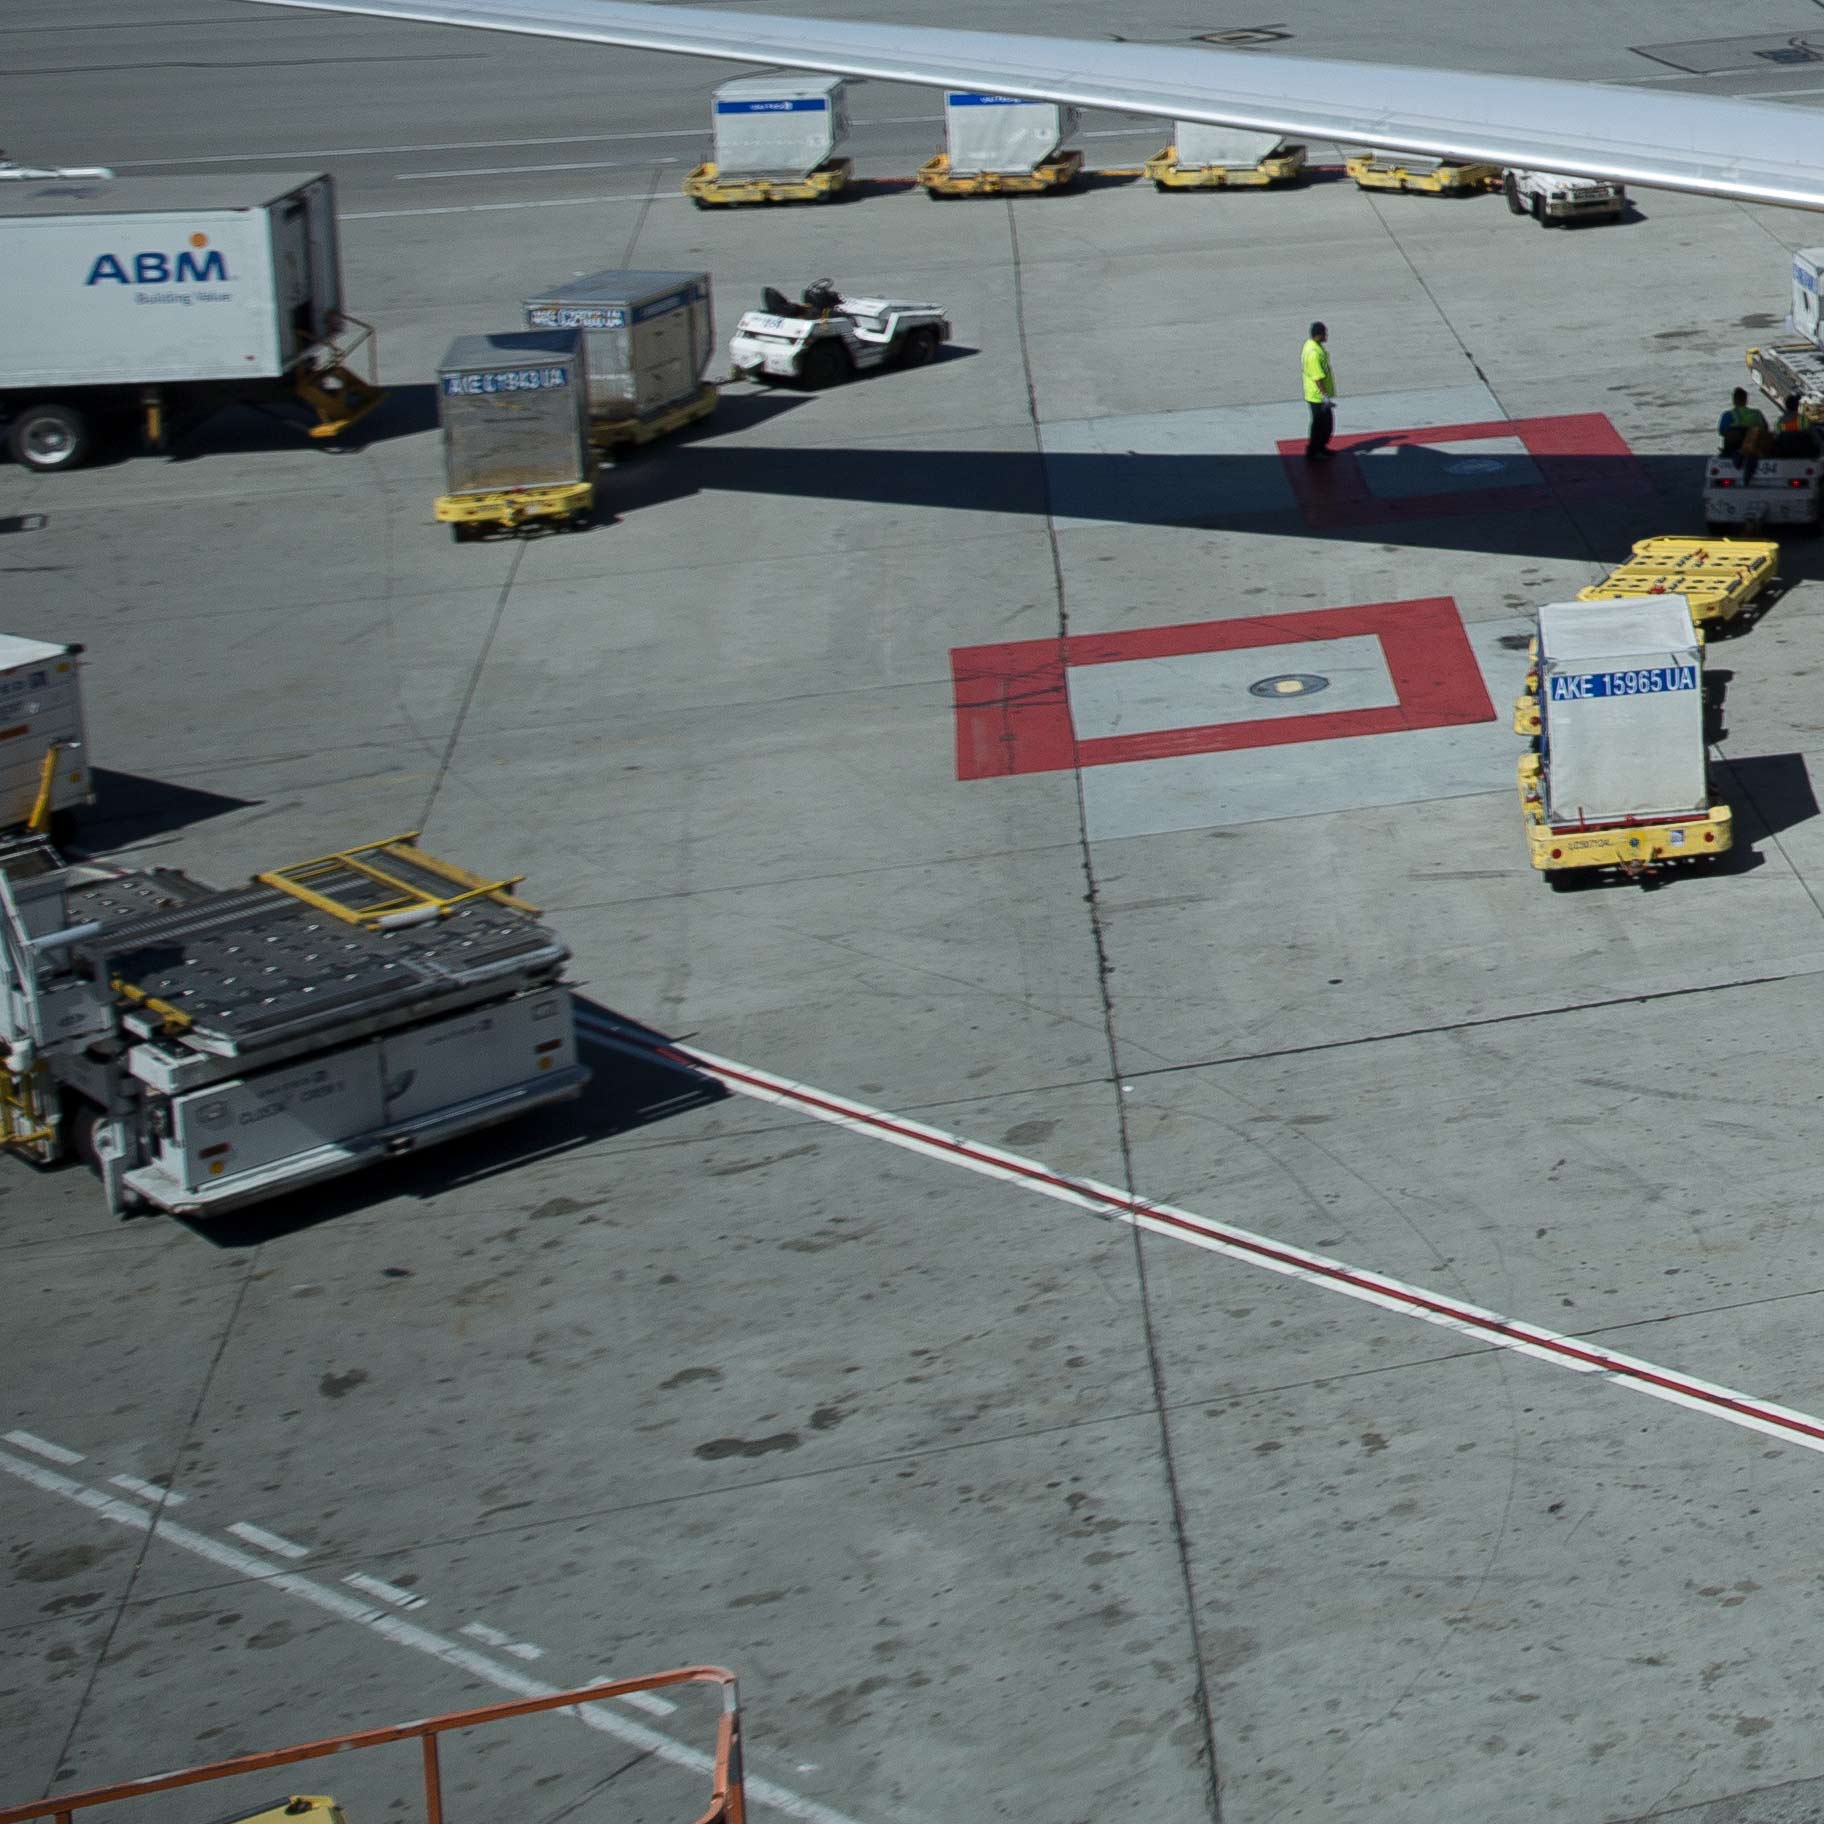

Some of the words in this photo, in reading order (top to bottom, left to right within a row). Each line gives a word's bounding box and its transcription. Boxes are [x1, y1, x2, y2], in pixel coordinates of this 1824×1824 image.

[85, 250, 229, 286] ABM
[1554, 675, 1595, 701] AKE
[1602, 669, 1663, 696] 15965
[1665, 666, 1694, 691] UA
